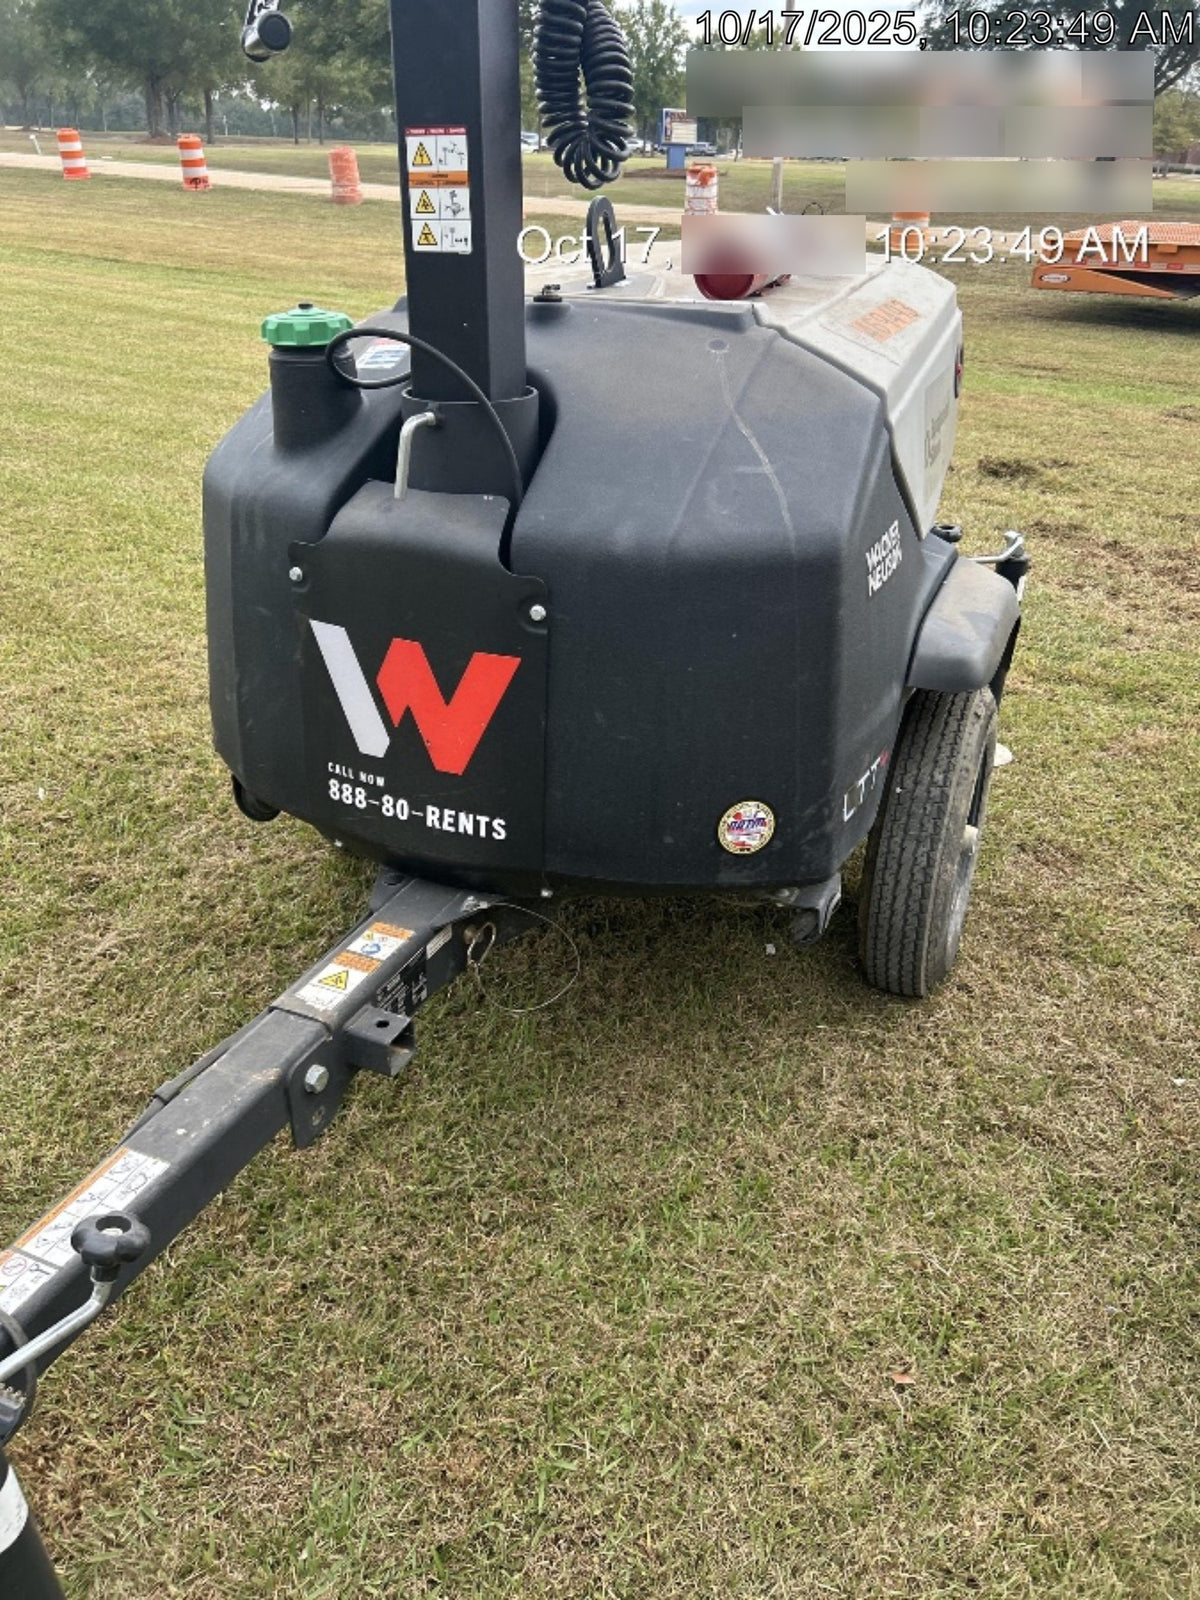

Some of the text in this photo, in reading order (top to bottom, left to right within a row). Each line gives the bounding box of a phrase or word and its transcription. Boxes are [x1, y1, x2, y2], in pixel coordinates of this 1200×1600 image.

[328, 762, 385, 787] CALL NOW
[328, 778, 507, 841] 888-80-RENTS
